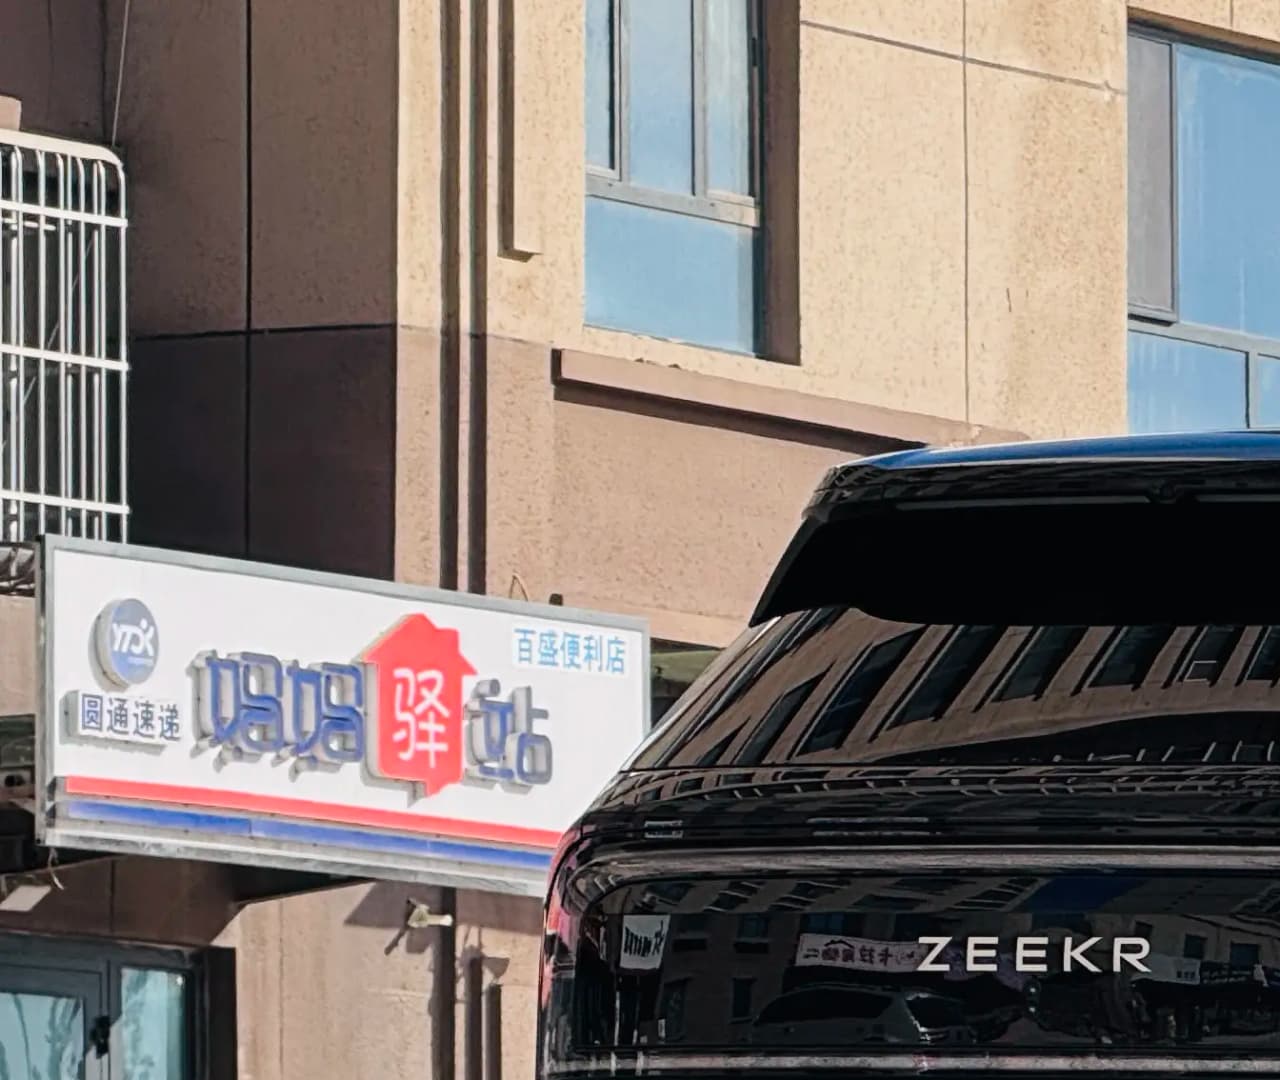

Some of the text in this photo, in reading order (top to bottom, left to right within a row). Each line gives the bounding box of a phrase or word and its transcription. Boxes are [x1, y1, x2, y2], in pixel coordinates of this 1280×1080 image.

[514, 628, 626, 674] 百盛便利店
[81, 693, 182, 741] 圆通速递
[200, 648, 553, 785] 妈妈驿站
[917, 936, 1152, 973] ZEEKR
